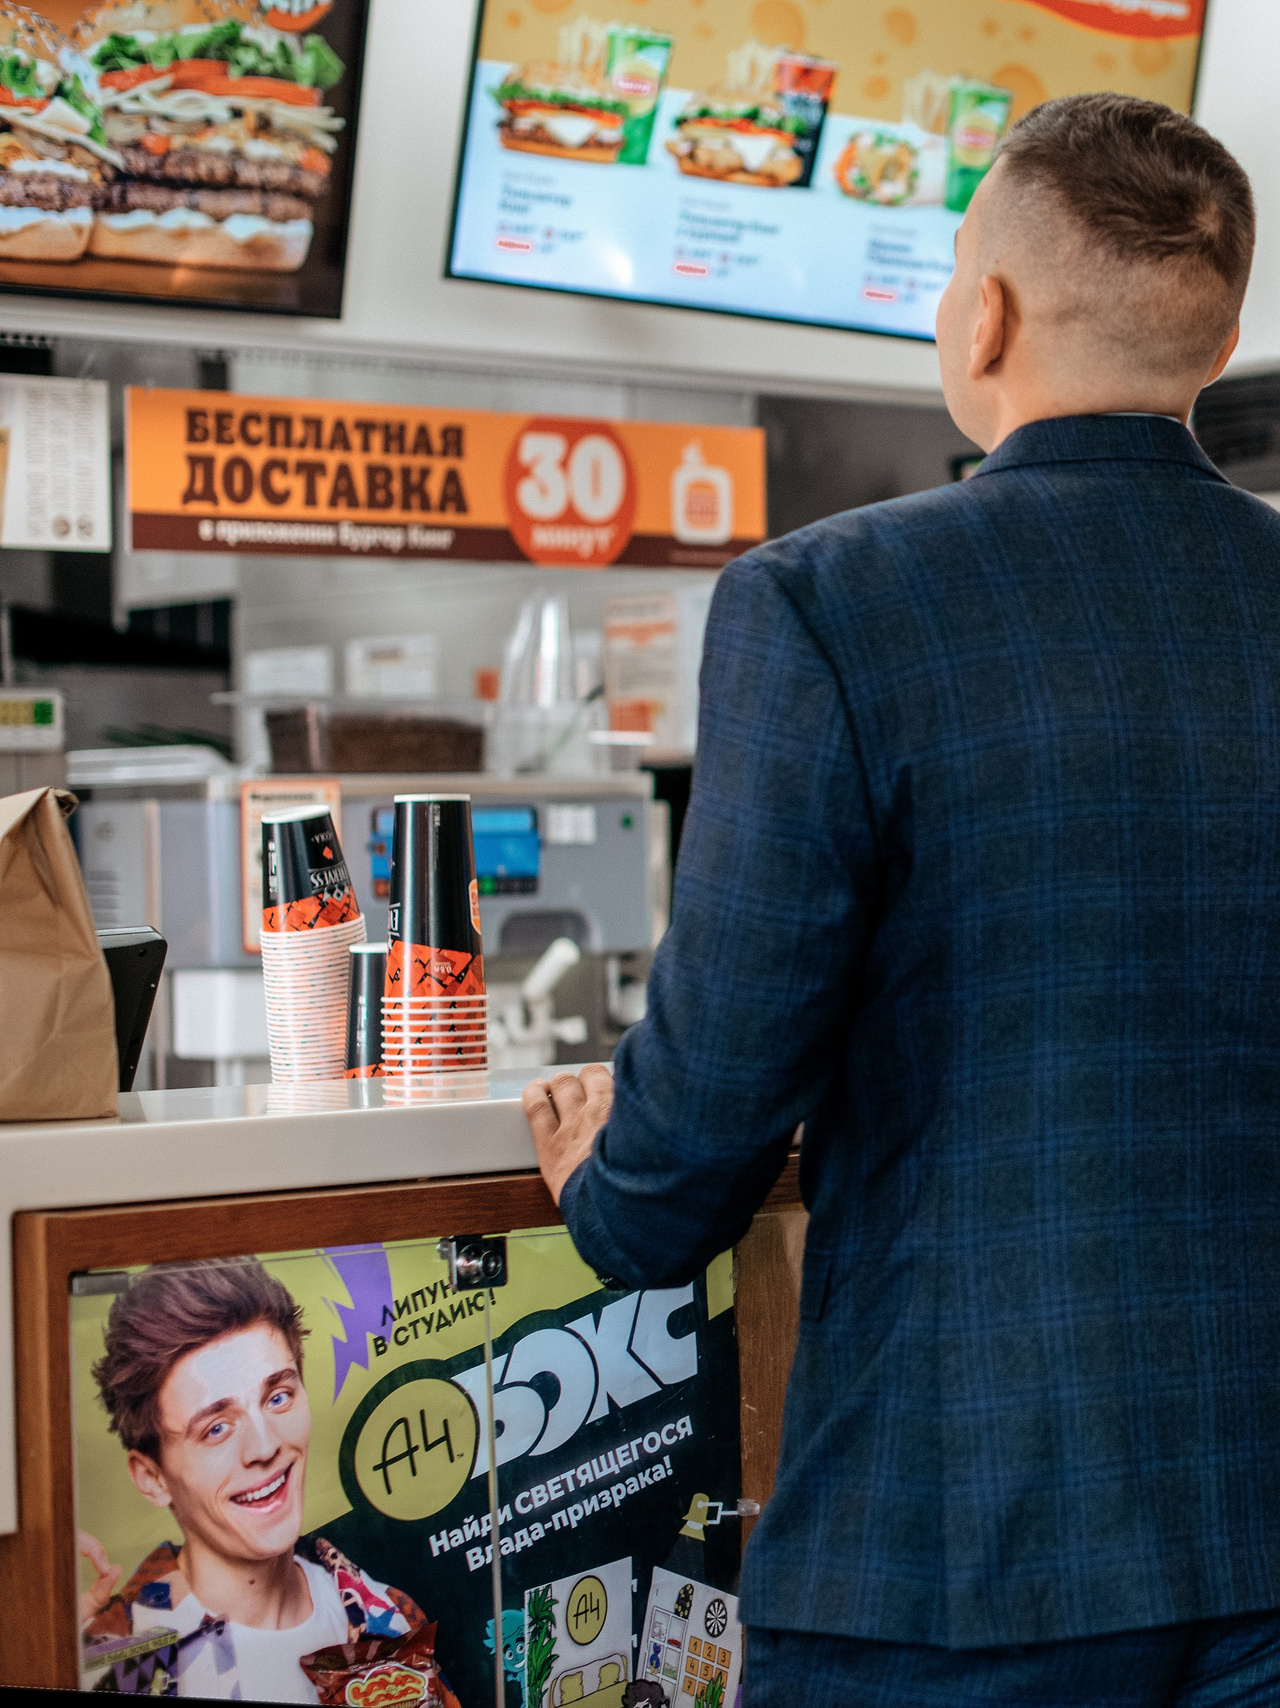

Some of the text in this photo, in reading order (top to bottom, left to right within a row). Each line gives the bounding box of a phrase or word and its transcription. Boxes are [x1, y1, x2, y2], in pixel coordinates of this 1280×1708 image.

[185, 407, 465, 459] БЕСПЛАТНАЯ
[180, 453, 470, 515] ДОСТАВКА
[516, 431, 628, 523] 30
[530, 522, 619, 560] минут
[373, 1287, 497, 1357] В СТУДИЮ!
[449, 1280, 699, 1480] БОКС
[428, 1414, 695, 1558] Найди СВЕТЯЩЕГОСЯ
[465, 1455, 675, 1573] Влада-призрака!
[689, 1659, 710, 1677] 4 5
[706, 1645, 713, 1658] 2
[721, 1651, 728, 1663] 3
